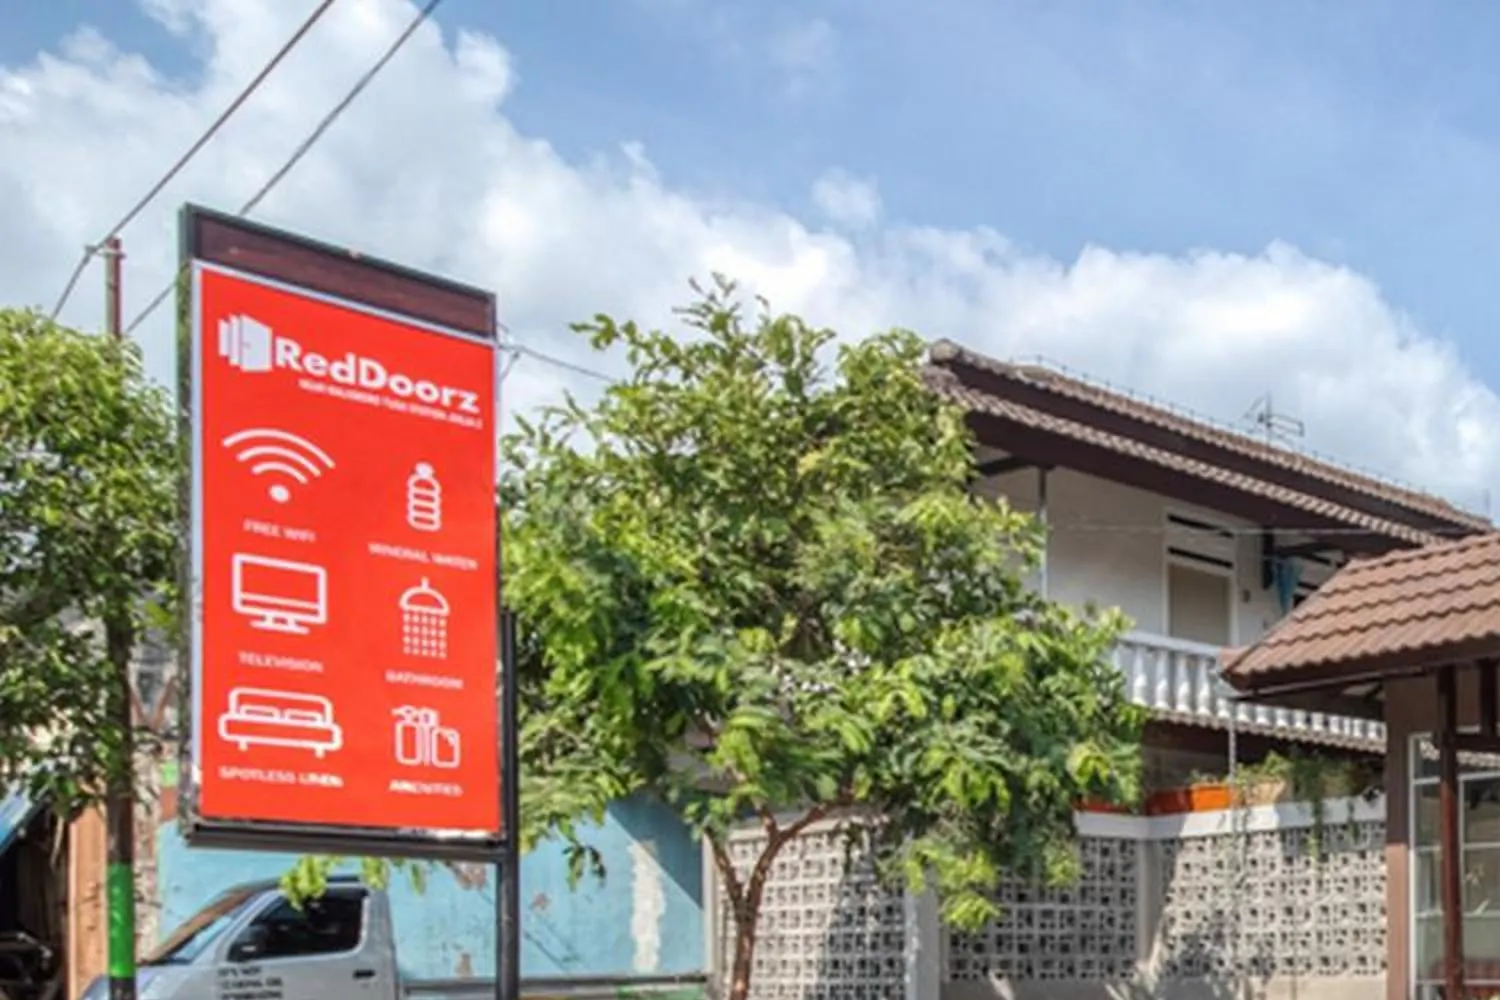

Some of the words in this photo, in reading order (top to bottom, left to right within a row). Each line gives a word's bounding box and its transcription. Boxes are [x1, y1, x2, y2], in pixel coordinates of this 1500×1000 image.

[275, 336, 480, 413] RedDoorz
[239, 650, 324, 673] TELEVISION
[218, 765, 296, 785] SPOTLESS
